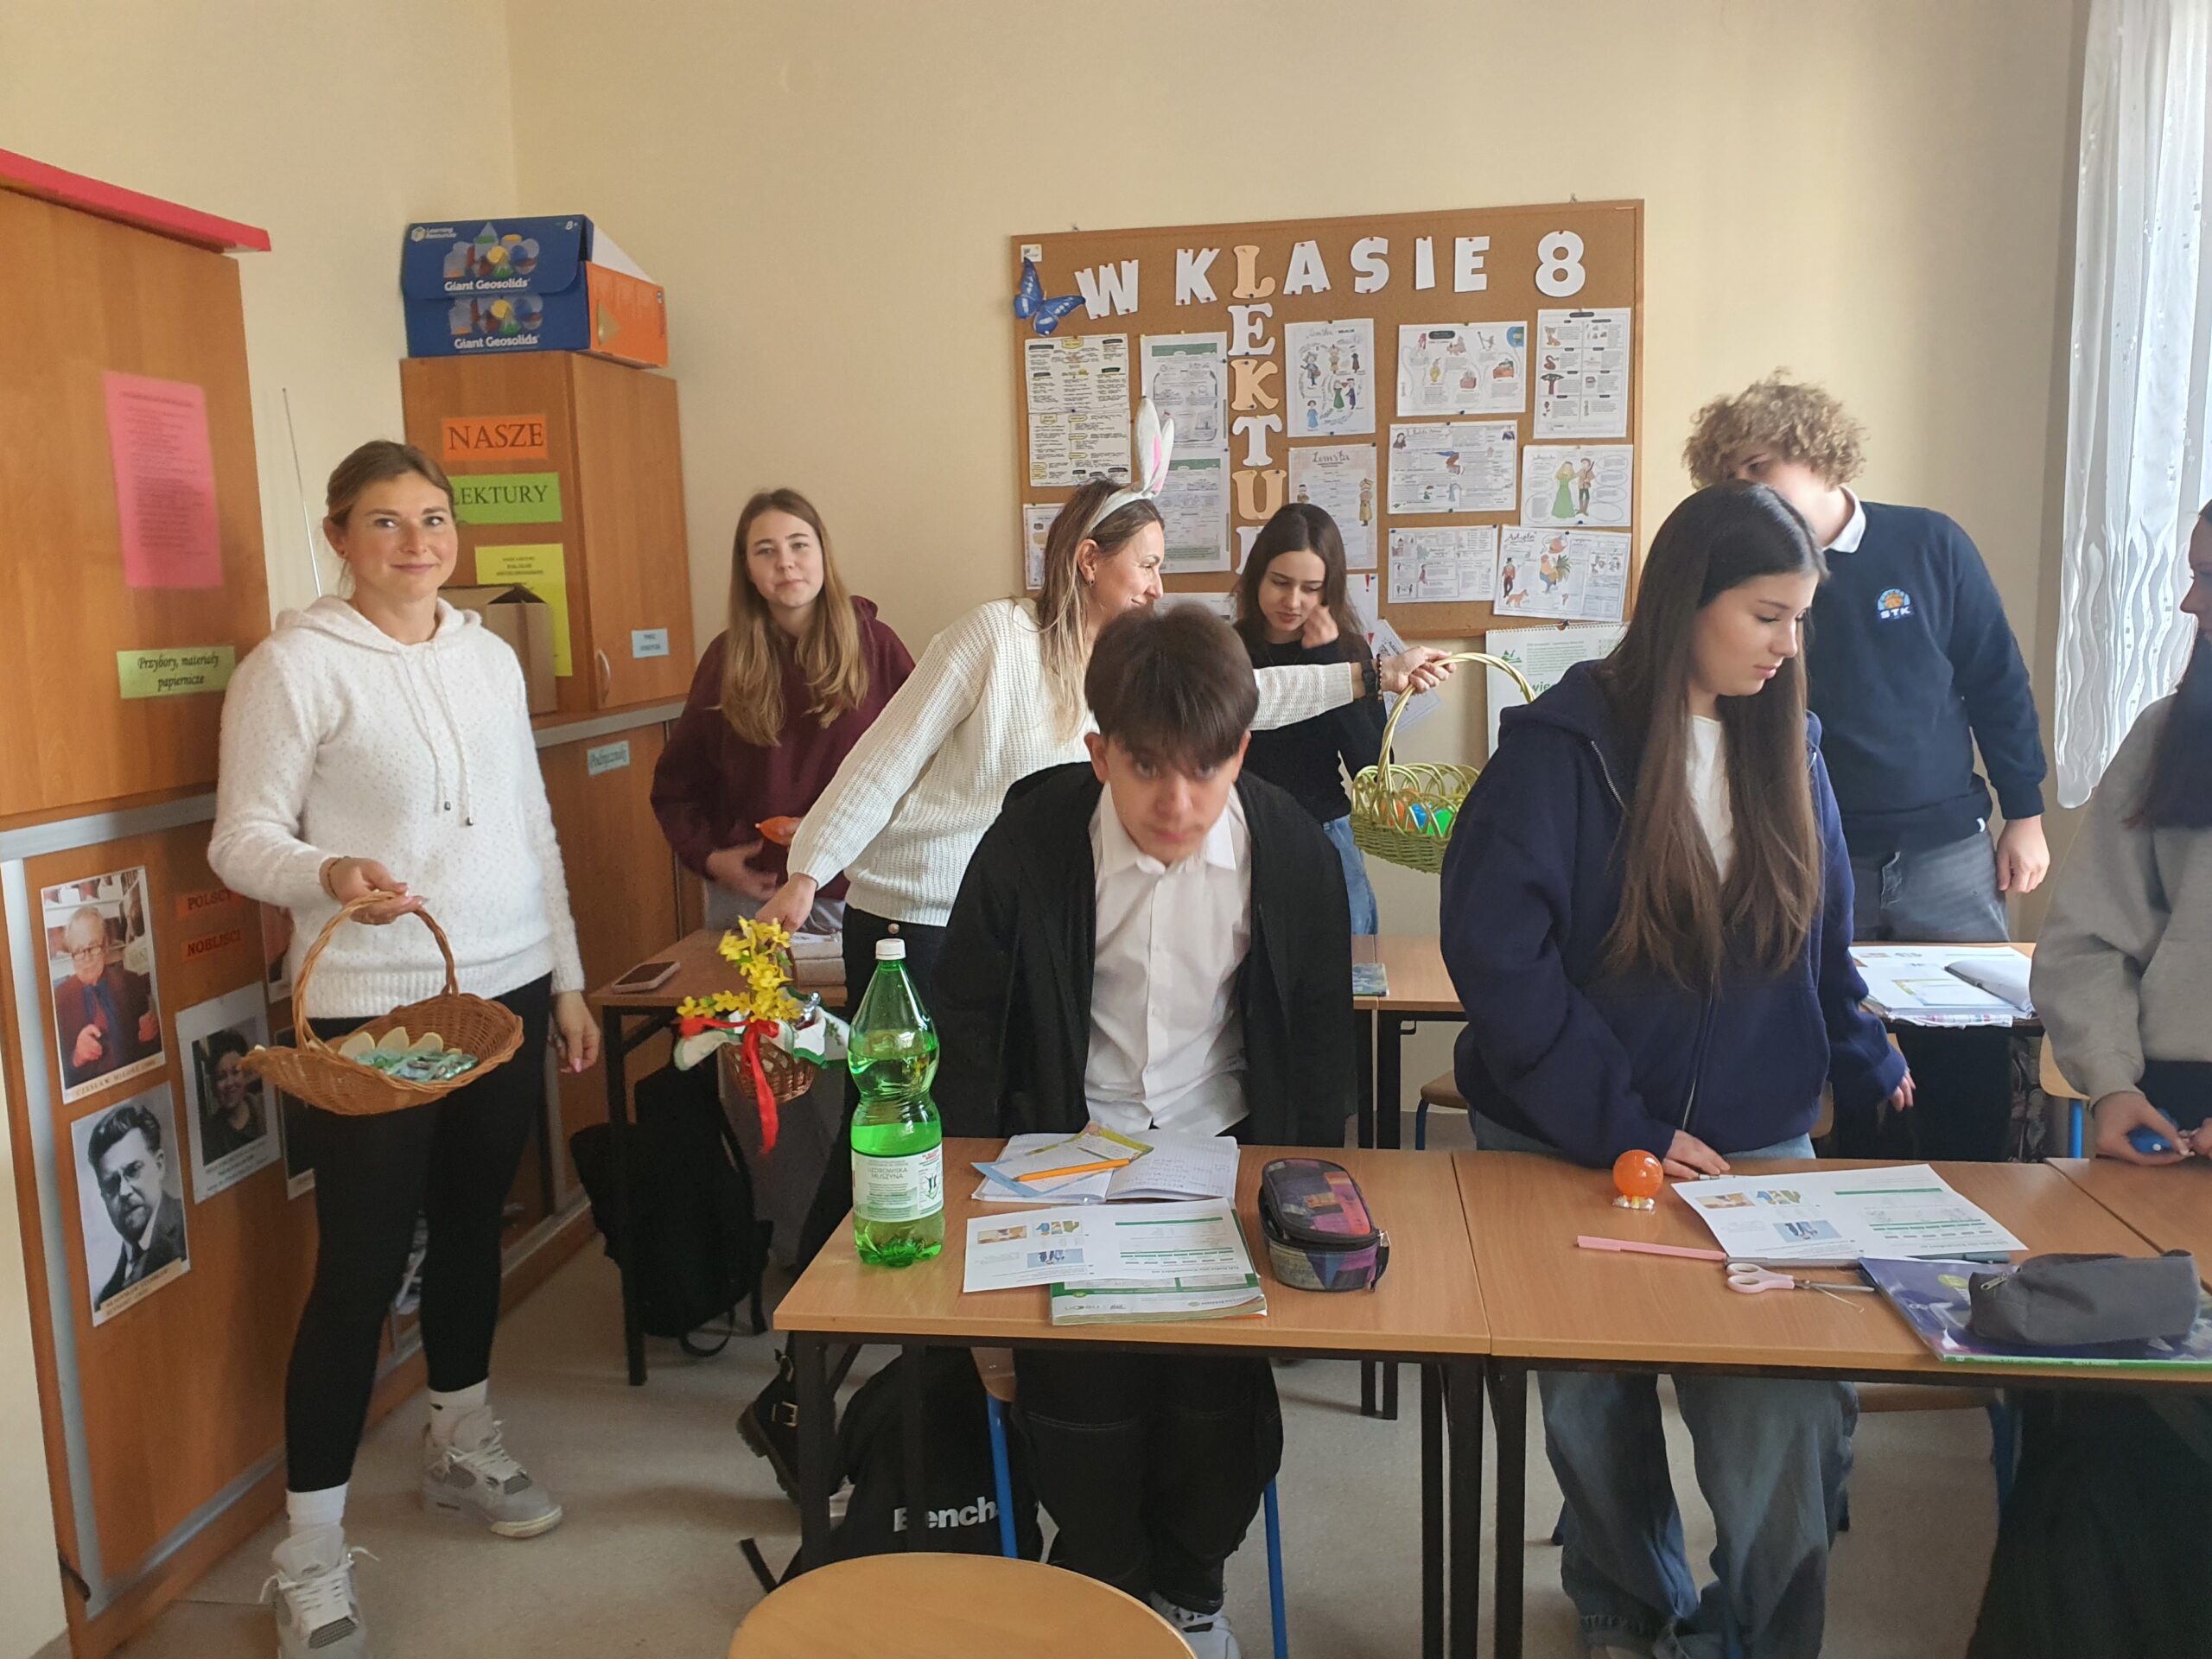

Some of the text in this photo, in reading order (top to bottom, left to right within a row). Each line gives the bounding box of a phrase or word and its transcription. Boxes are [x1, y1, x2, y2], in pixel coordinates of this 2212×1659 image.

[445, 278, 529, 292] Giant Geosolids
[1074, 229, 1587, 320] W KLASIE 8
[454, 334, 538, 349] Giant Geosolids
[448, 423, 544, 450] NASZE
